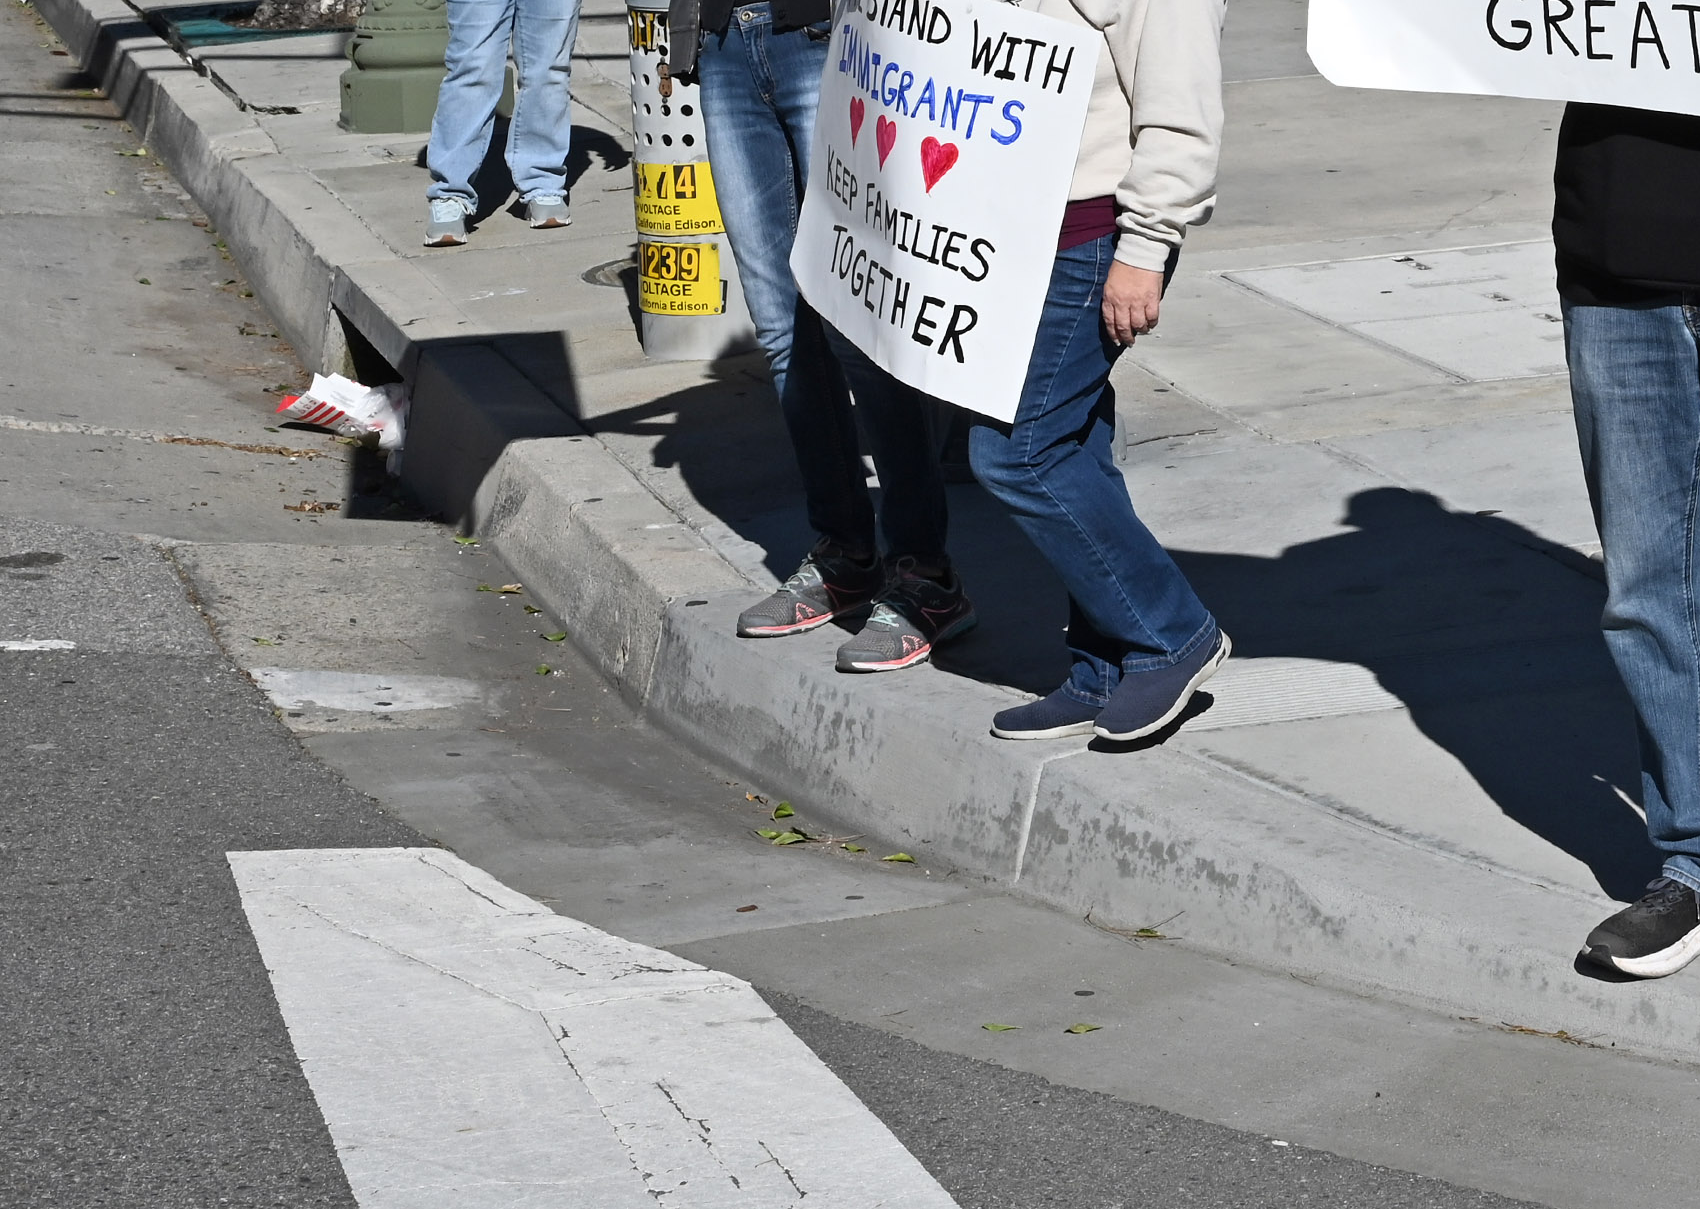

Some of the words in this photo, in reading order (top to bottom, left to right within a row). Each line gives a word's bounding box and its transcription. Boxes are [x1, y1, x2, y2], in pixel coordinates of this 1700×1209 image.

[838, 23, 1026, 146] IMMIGRANTS
[970, 18, 1075, 94] WITH
[674, 218, 716, 230] Edison
[826, 144, 859, 211] KEEP
[865, 182, 996, 282] FAMILIES
[642, 280, 692, 297] OLTAGE
[669, 301, 708, 311] Edison
[830, 224, 979, 364] TOGETHER
